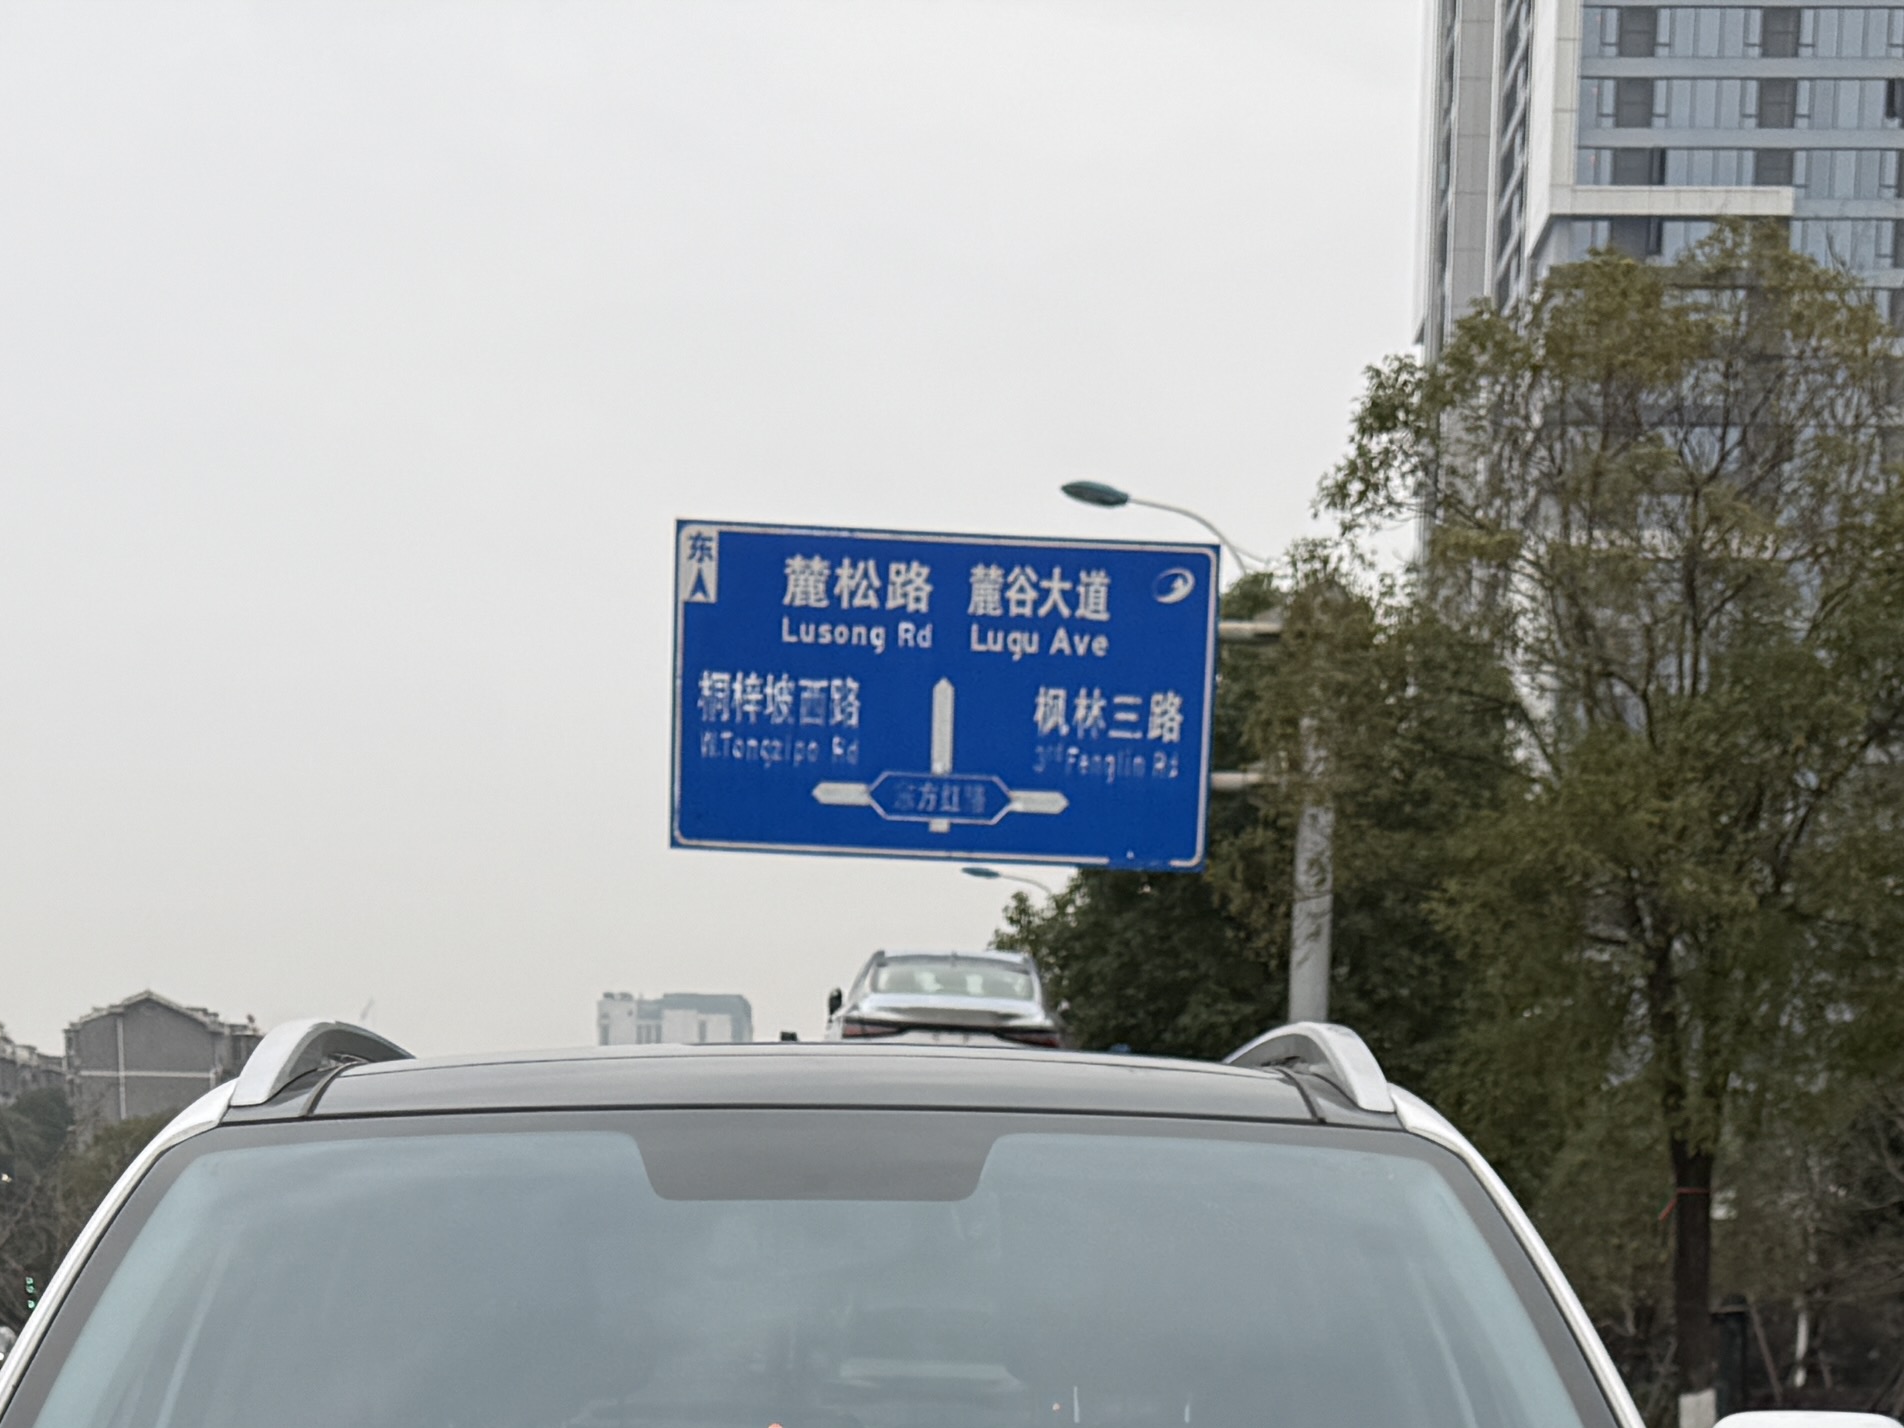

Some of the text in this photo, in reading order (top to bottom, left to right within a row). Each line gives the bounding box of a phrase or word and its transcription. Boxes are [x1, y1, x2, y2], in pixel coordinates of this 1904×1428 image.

[687, 531, 715, 562] 东
[782, 554, 933, 614] 麓松路
[967, 562, 1111, 622] 麓谷大道
[782, 616, 933, 653] Lusong Rd
[970, 624, 1109, 661] Lugu Ave
[697, 670, 861, 728] 桐梓坡西路
[1034, 685, 1184, 744] 枫林三路
